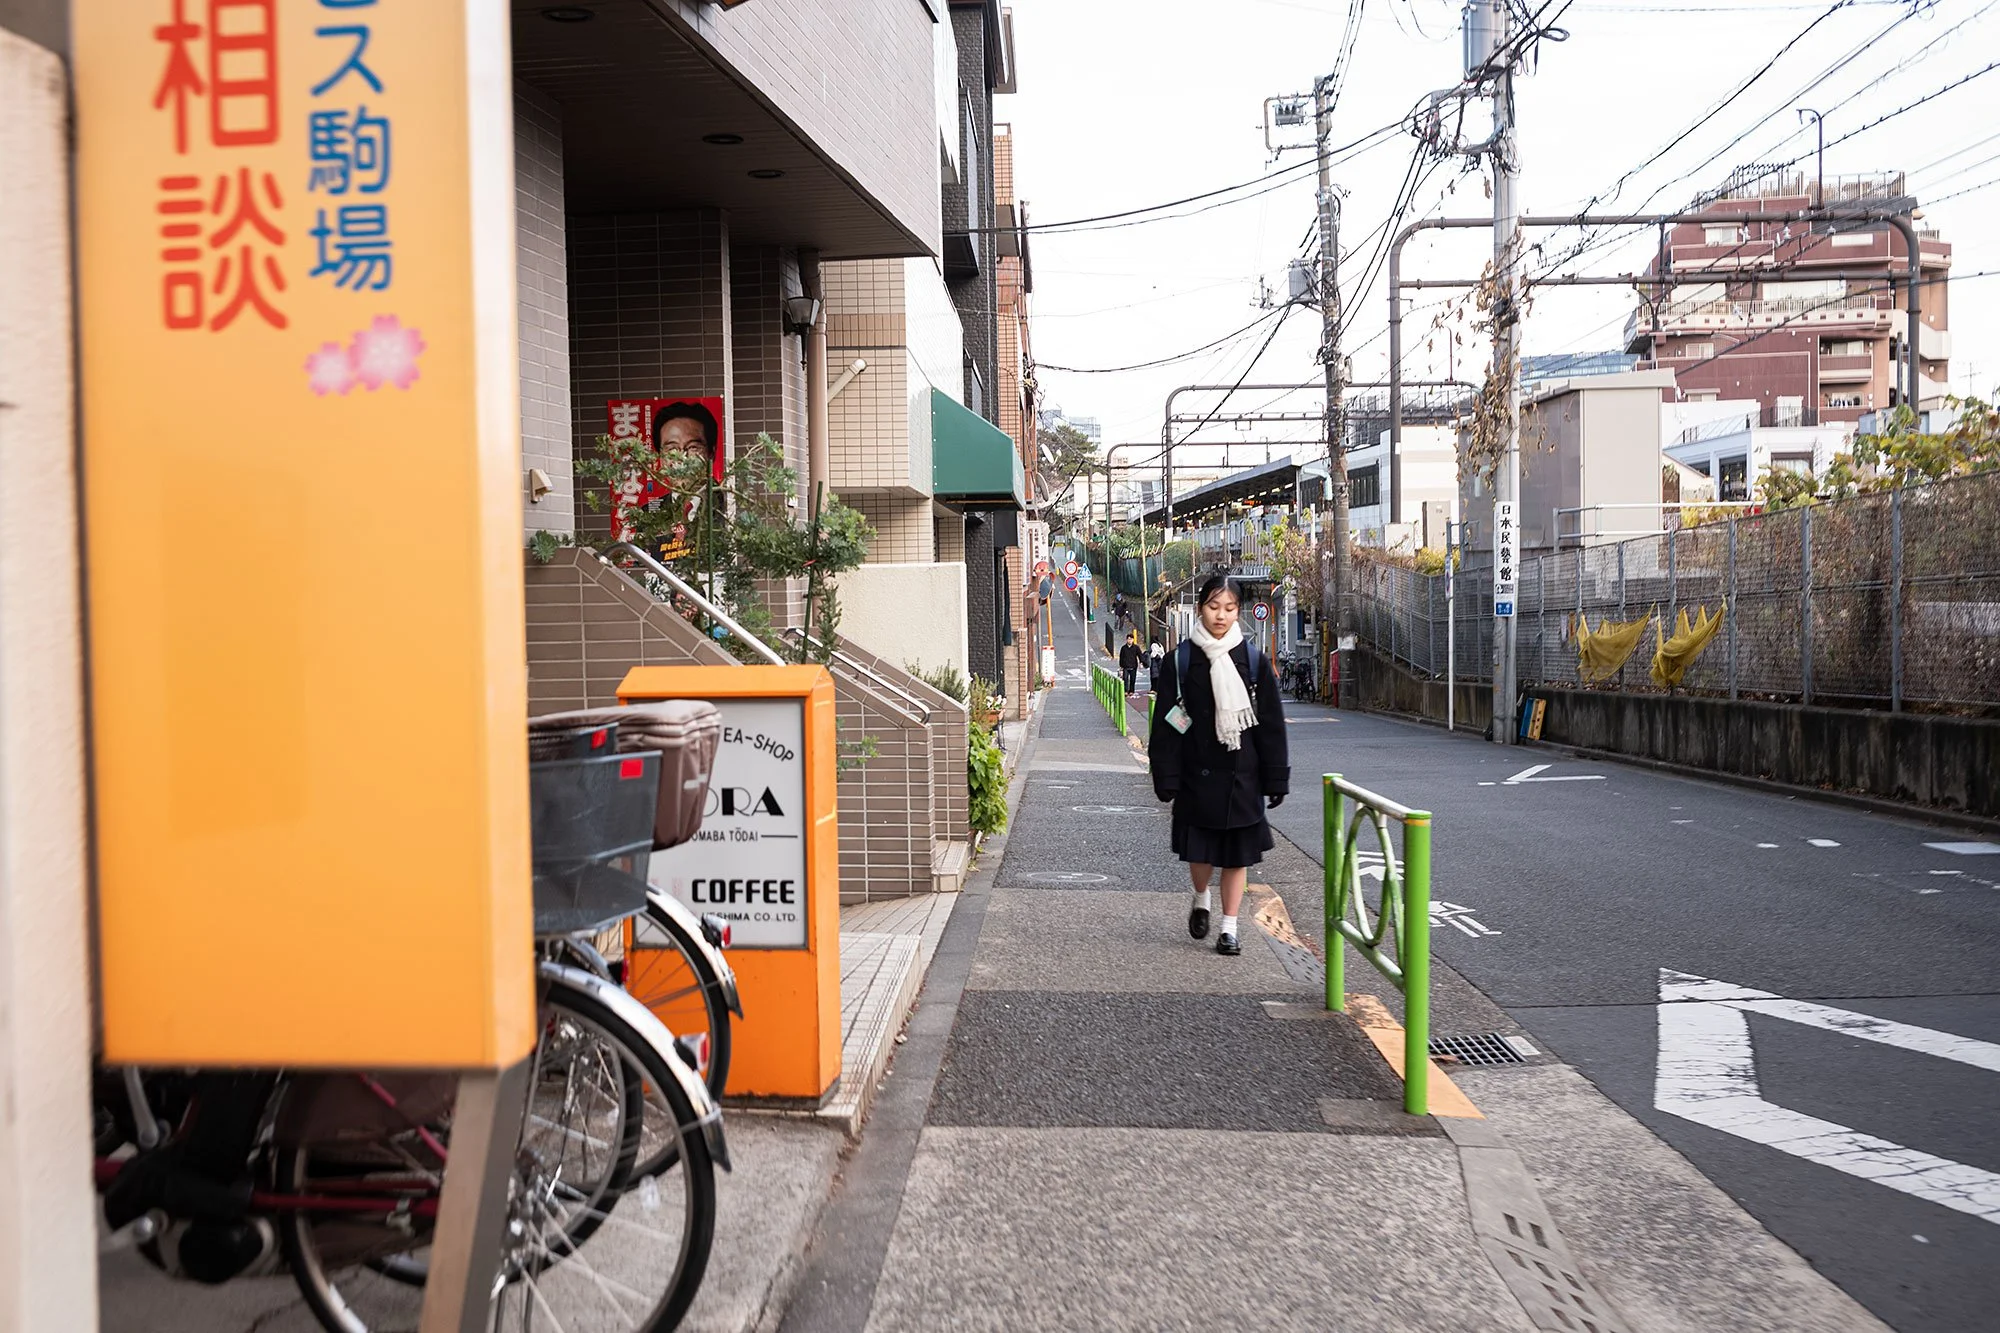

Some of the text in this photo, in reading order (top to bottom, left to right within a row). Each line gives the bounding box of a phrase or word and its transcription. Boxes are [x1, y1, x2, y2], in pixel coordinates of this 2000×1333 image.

[152, 0, 289, 332] 相談
[307, 0, 394, 291] ス駒場
[691, 879, 795, 904] COFFEE
